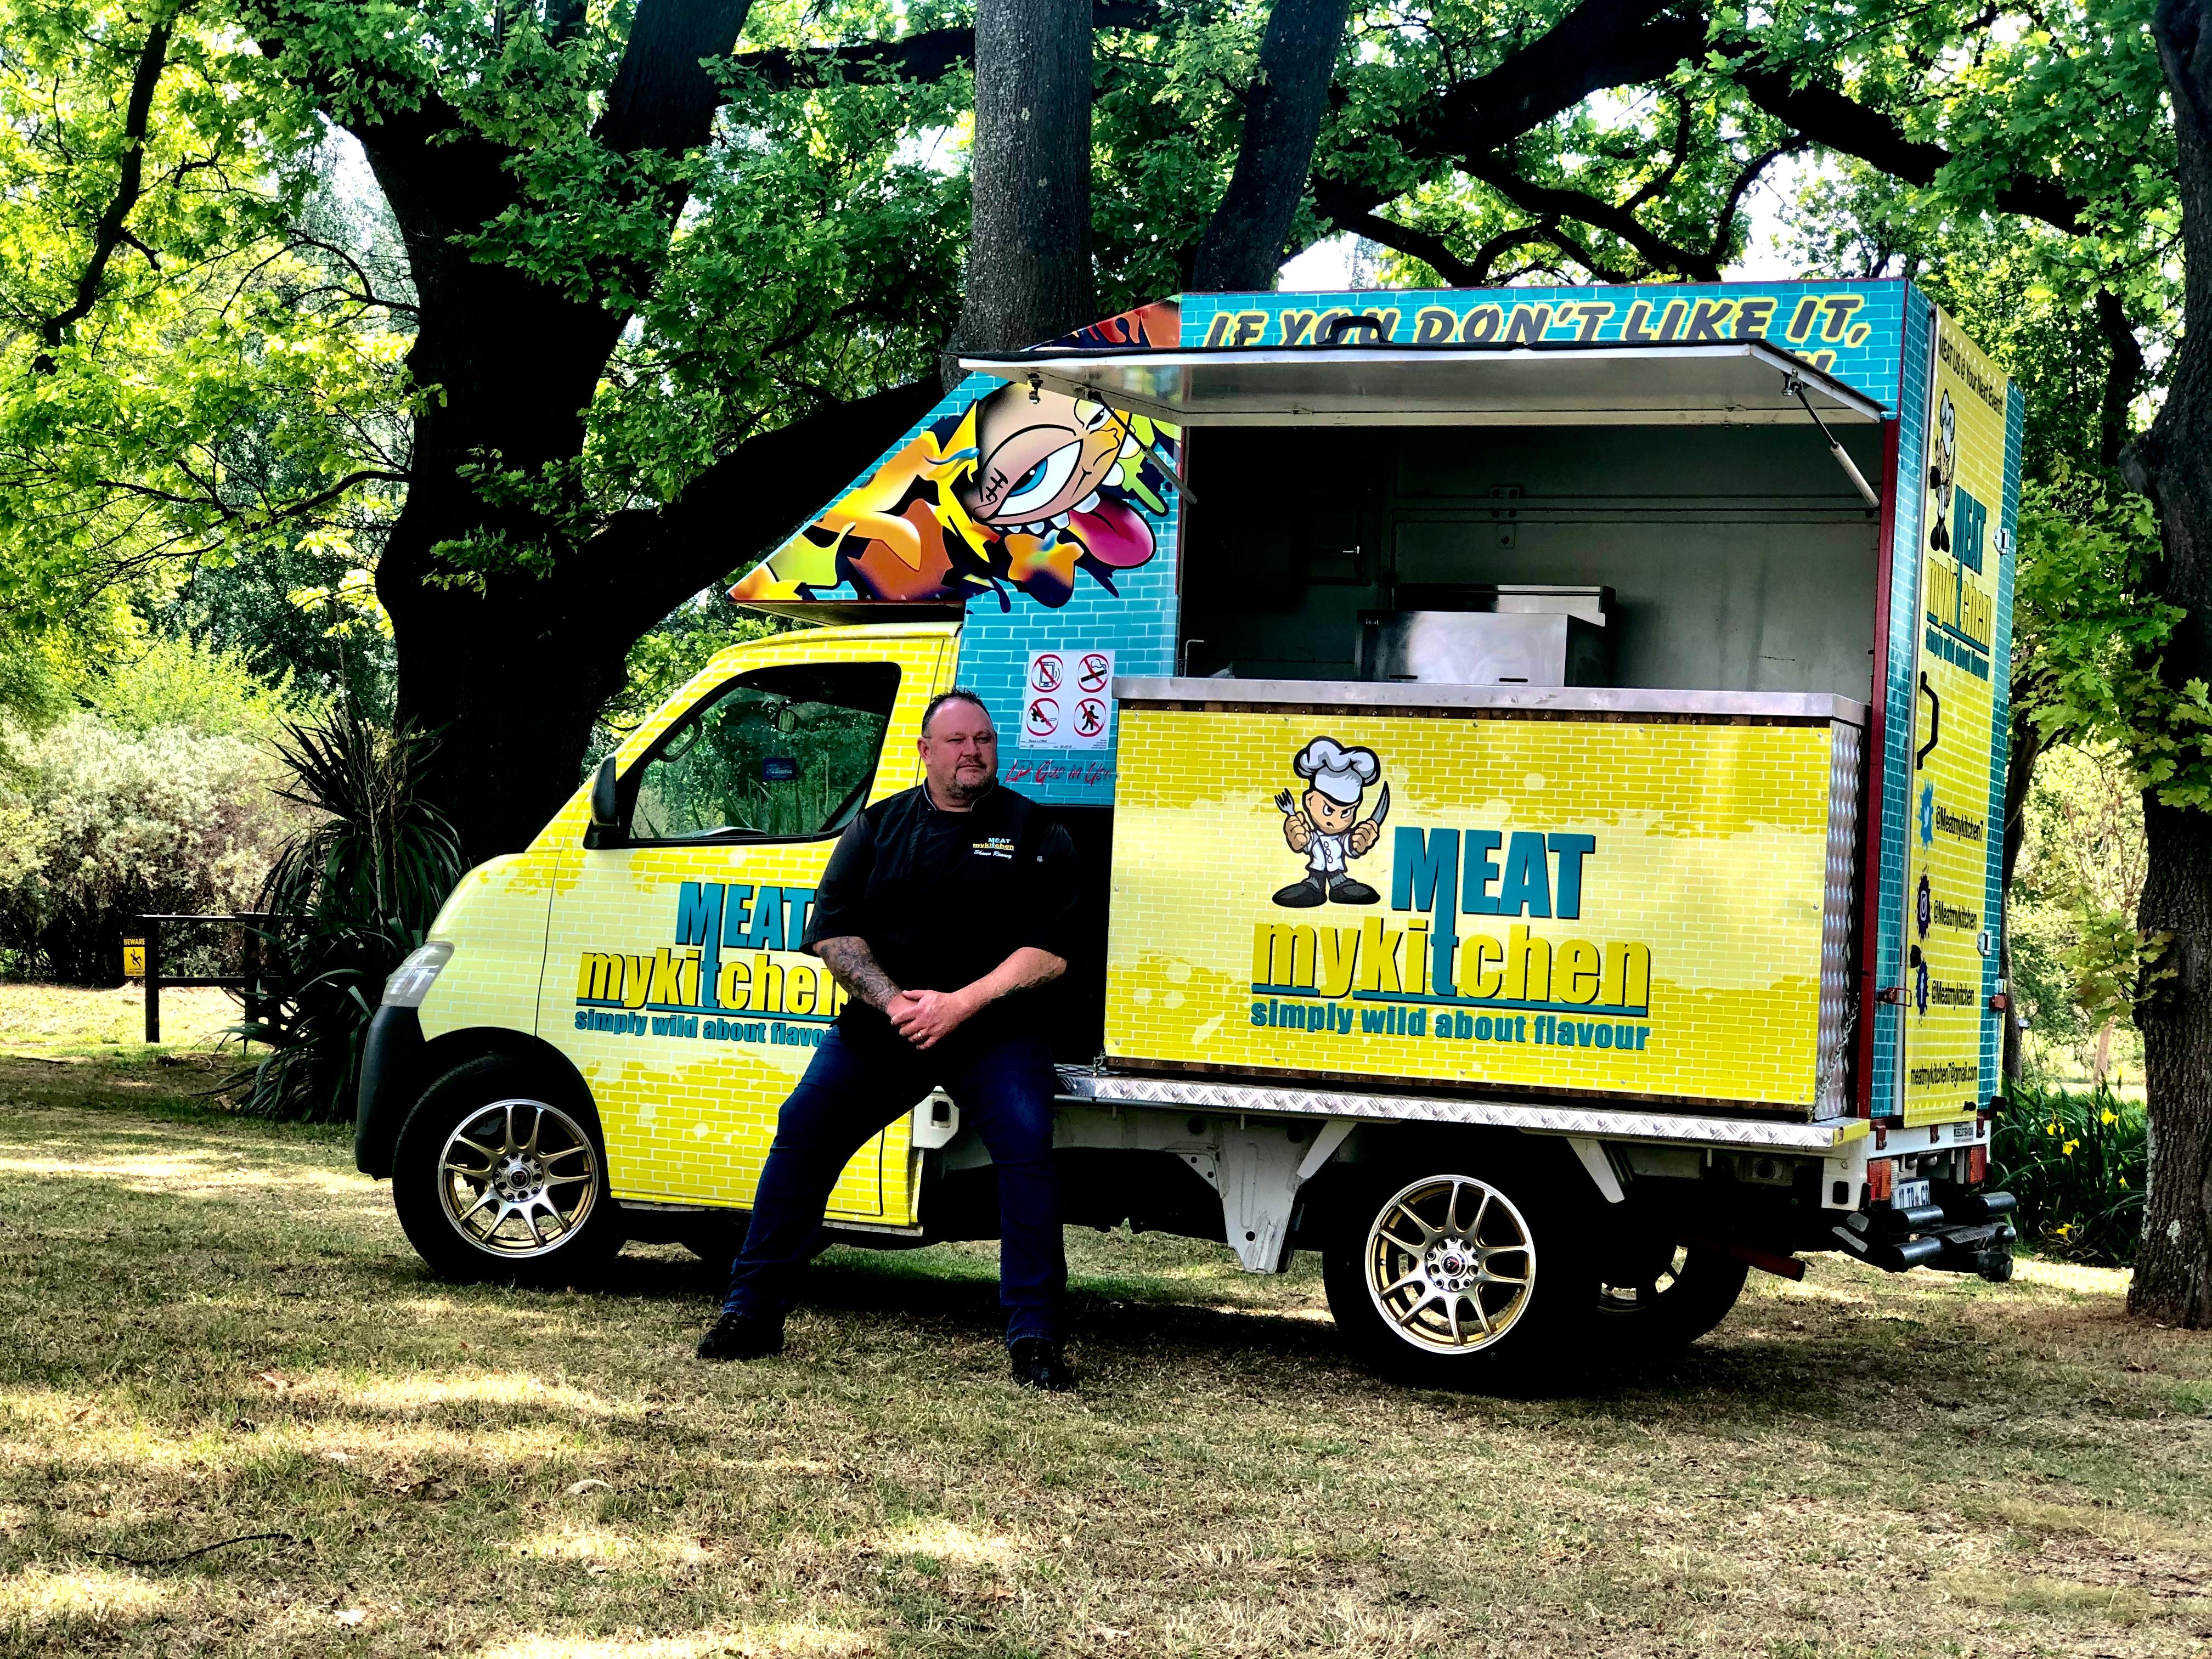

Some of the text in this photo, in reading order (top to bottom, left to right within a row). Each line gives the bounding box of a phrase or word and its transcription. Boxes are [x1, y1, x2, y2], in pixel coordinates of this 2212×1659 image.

[1205, 314, 1266, 347] IF
[1416, 306, 1612, 343] DON'T
[1624, 301, 1775, 341] LIKE
[1789, 298, 1868, 344] IT,
[1939, 334, 1953, 366] MEAT
[1953, 349, 1960, 375] US
[1966, 362, 1977, 391] Your
[1952, 484, 1987, 576] MEAT
[1927, 556, 1991, 647] mykitchen
[1068, 765, 1082, 780] in
[1936, 805, 1984, 842] @Meatmykitchen7
[1391, 826, 1595, 919] MEAT
[675, 881, 817, 952] MEAT
[1933, 899, 1977, 933] @Meatmykitchen
[1252, 917, 1652, 1007] mykitchen
[575, 1009, 827, 1048] simply wild about flavo
[1251, 999, 1650, 1051] simply wild about flavour
